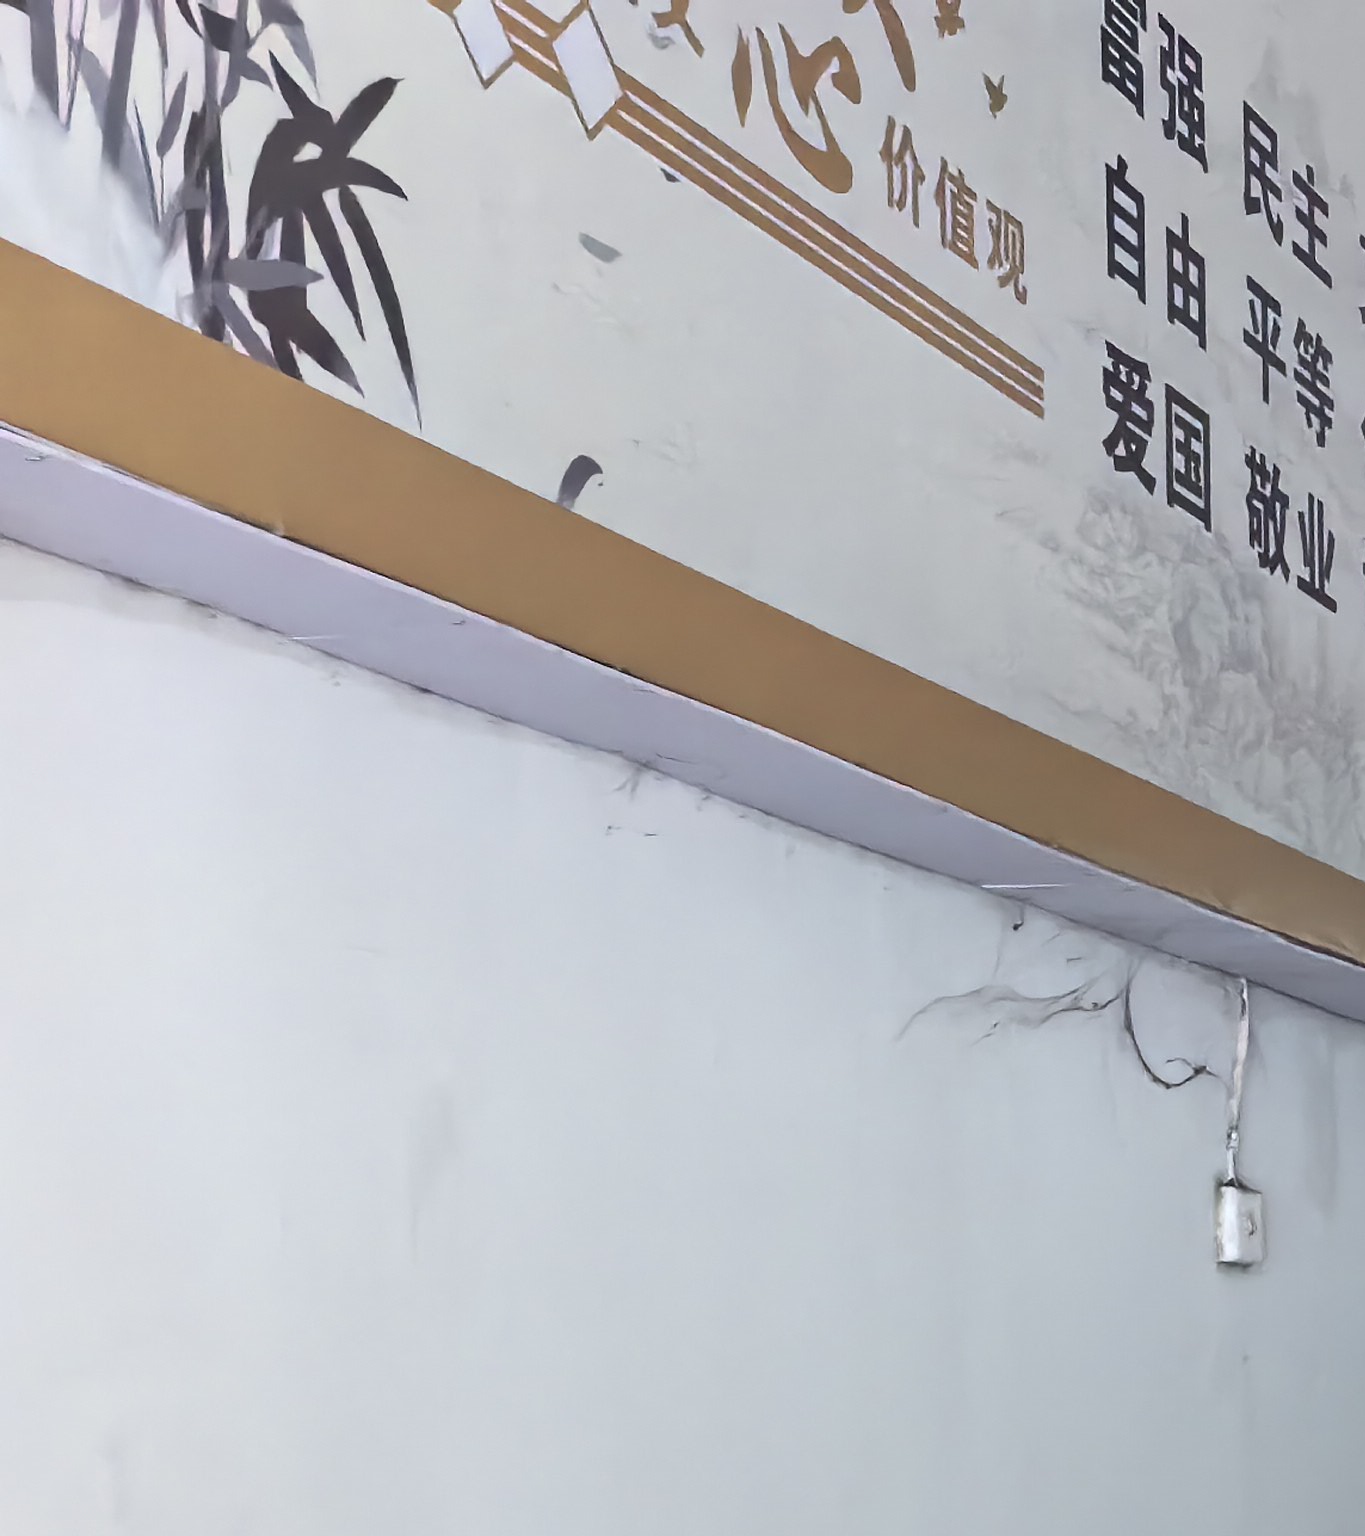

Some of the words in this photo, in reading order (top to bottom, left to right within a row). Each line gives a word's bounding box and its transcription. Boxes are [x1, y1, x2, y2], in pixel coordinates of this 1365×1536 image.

[879, 115, 1027, 305] 价值观
[1101, 0, 1208, 173] 富强
[1243, 100, 1332, 289] 民主
[1105, 154, 1207, 351] 自由
[1243, 275, 1335, 447] 平等
[1102, 339, 1212, 532] 爱国
[1244, 445, 1337, 614] 敬业
